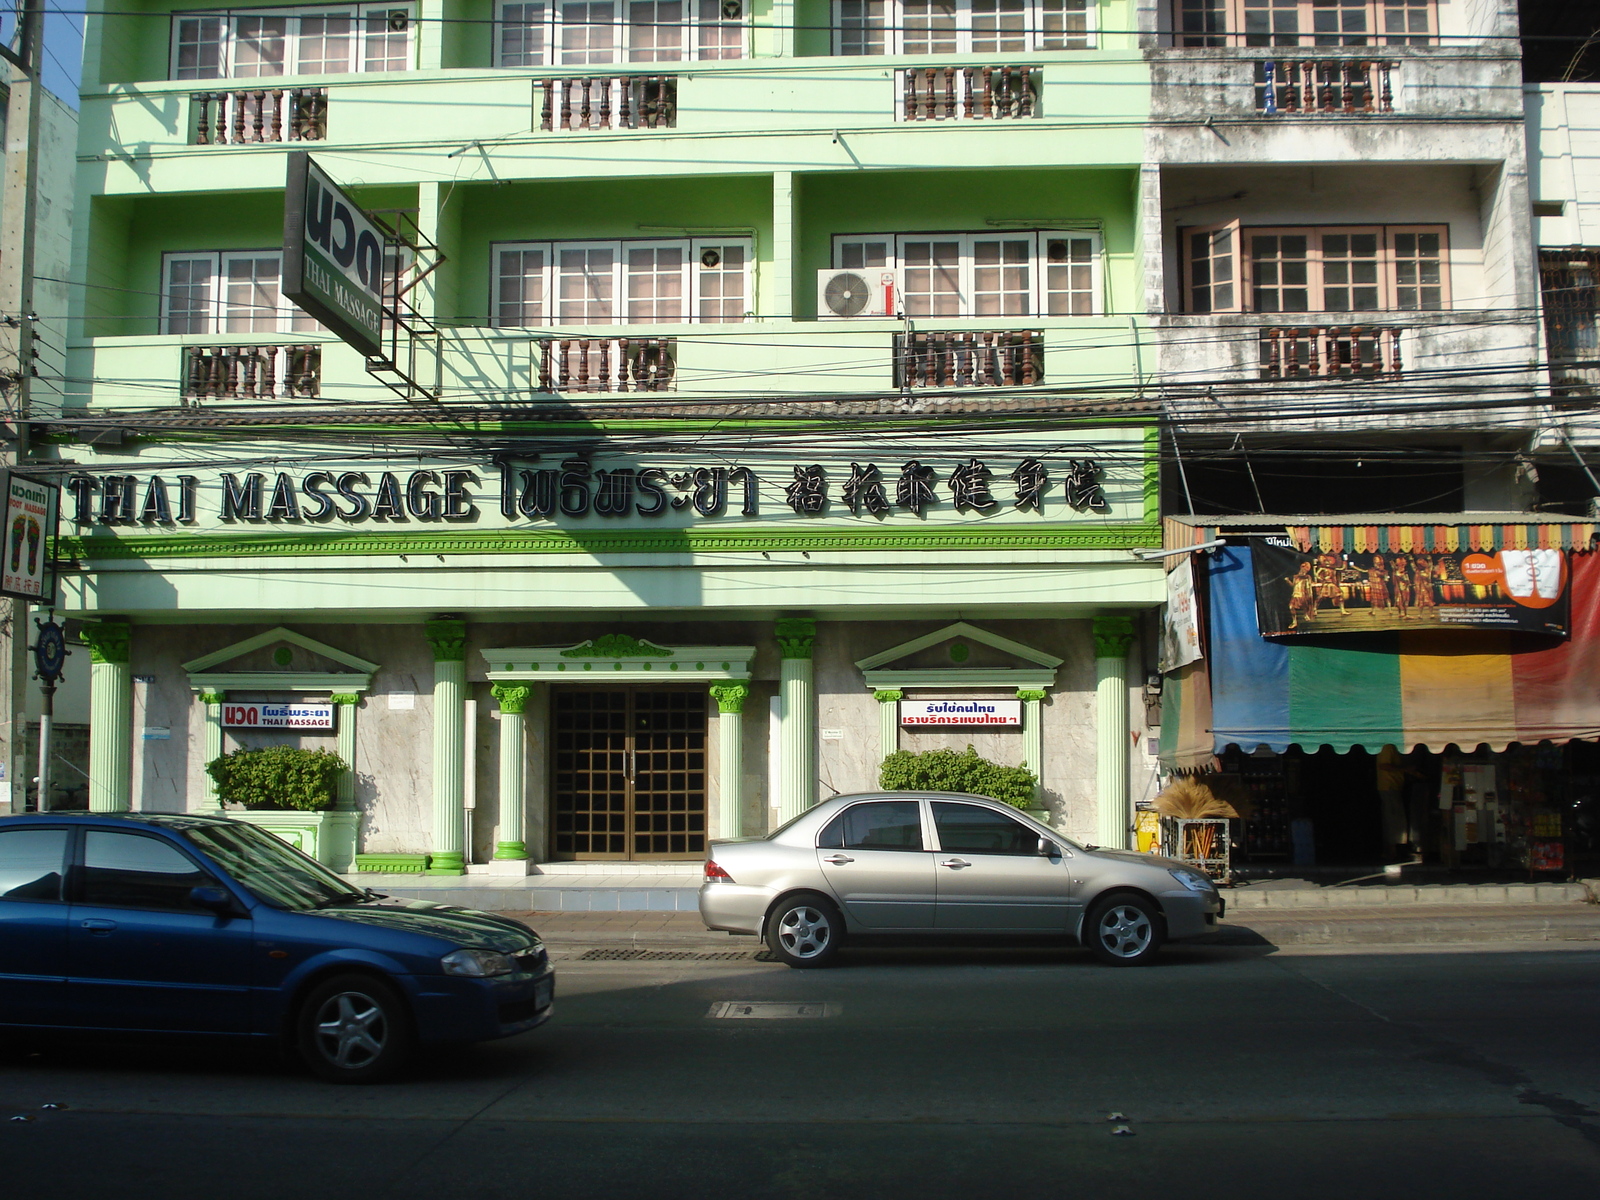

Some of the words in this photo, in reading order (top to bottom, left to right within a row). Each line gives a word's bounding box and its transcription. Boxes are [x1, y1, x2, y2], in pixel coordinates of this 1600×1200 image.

[307, 174, 381, 297] นวด
[304, 254, 331, 297] THAI
[333, 280, 380, 335] MASSAGE
[68, 474, 198, 524] THAI
[219, 470, 477, 524] MASSAGE
[24, 502, 46, 516] MASSAGE
[225, 706, 258, 725] นวด
[926, 702, 995, 713] รับใช้คนไทย
[262, 718, 283, 726] THAI
[286, 718, 330, 726] MASSAGE
